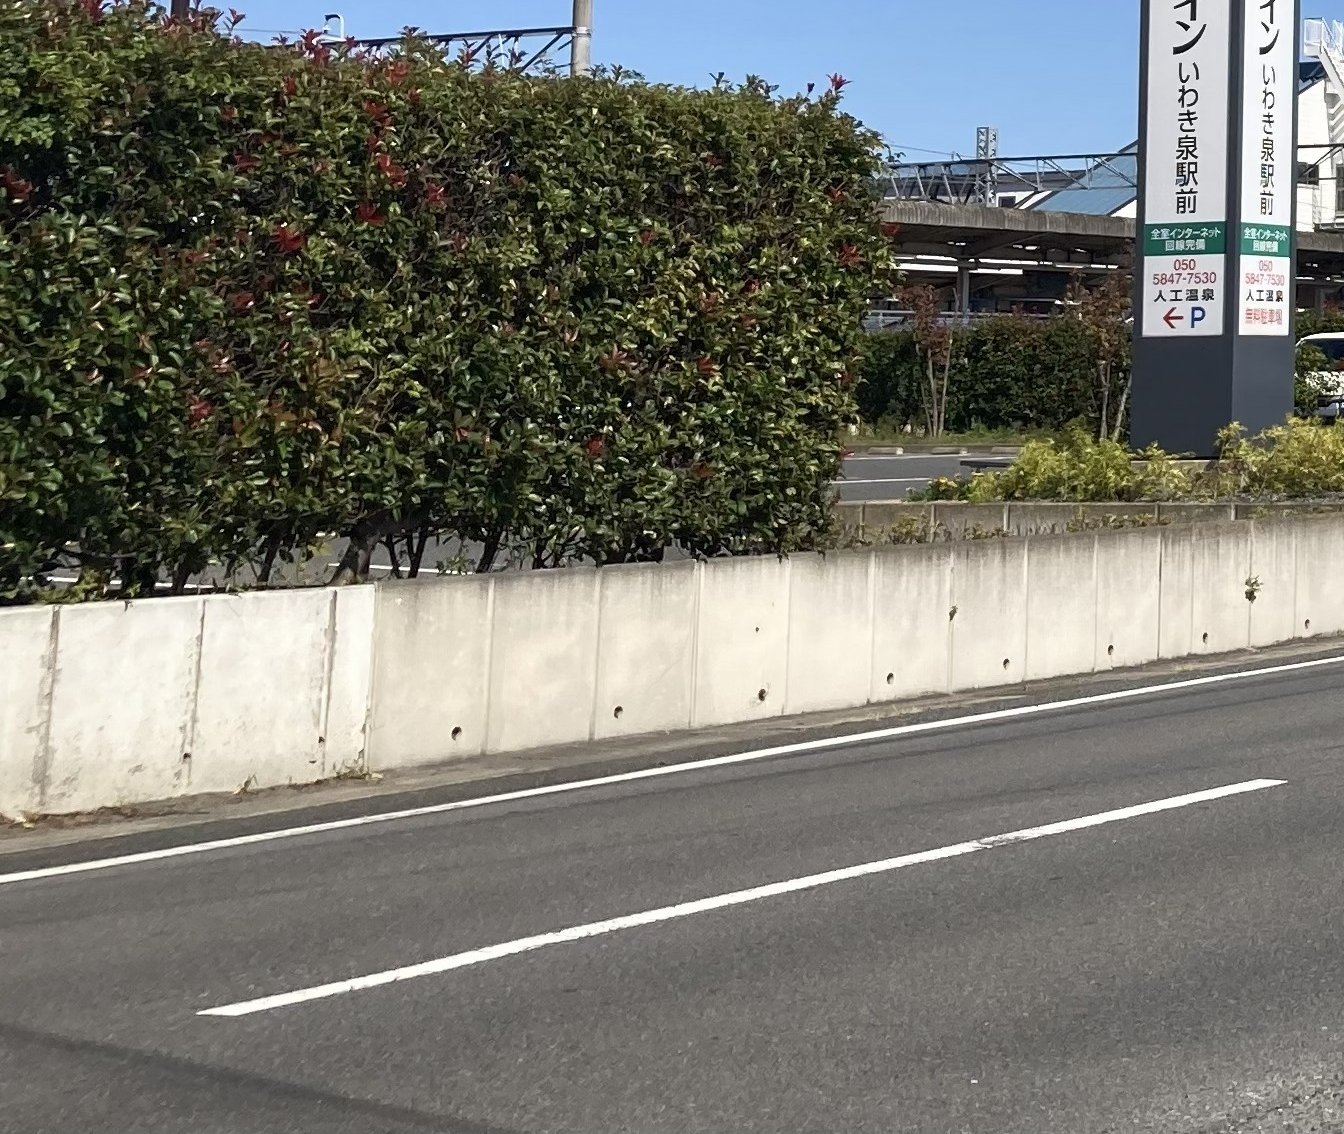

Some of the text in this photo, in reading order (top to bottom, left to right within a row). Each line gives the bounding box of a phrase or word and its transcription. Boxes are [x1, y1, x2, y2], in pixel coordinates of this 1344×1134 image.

[1175, 62, 1200, 215] いわき泉駅前
[1259, 63, 1276, 216] いわき泉駅前
[1150, 226, 1222, 241] 全室インターネット
[1173, 258, 1196, 271] 050
[1258, 260, 1273, 272] 050
[1152, 272, 1217, 286] 5847-7530
[1245, 272, 1285, 287] 5847-7530
[1153, 288, 1215, 302] 人工温泉
[1245, 288, 1284, 303] 人工温泉
[1190, 306, 1206, 328] P
